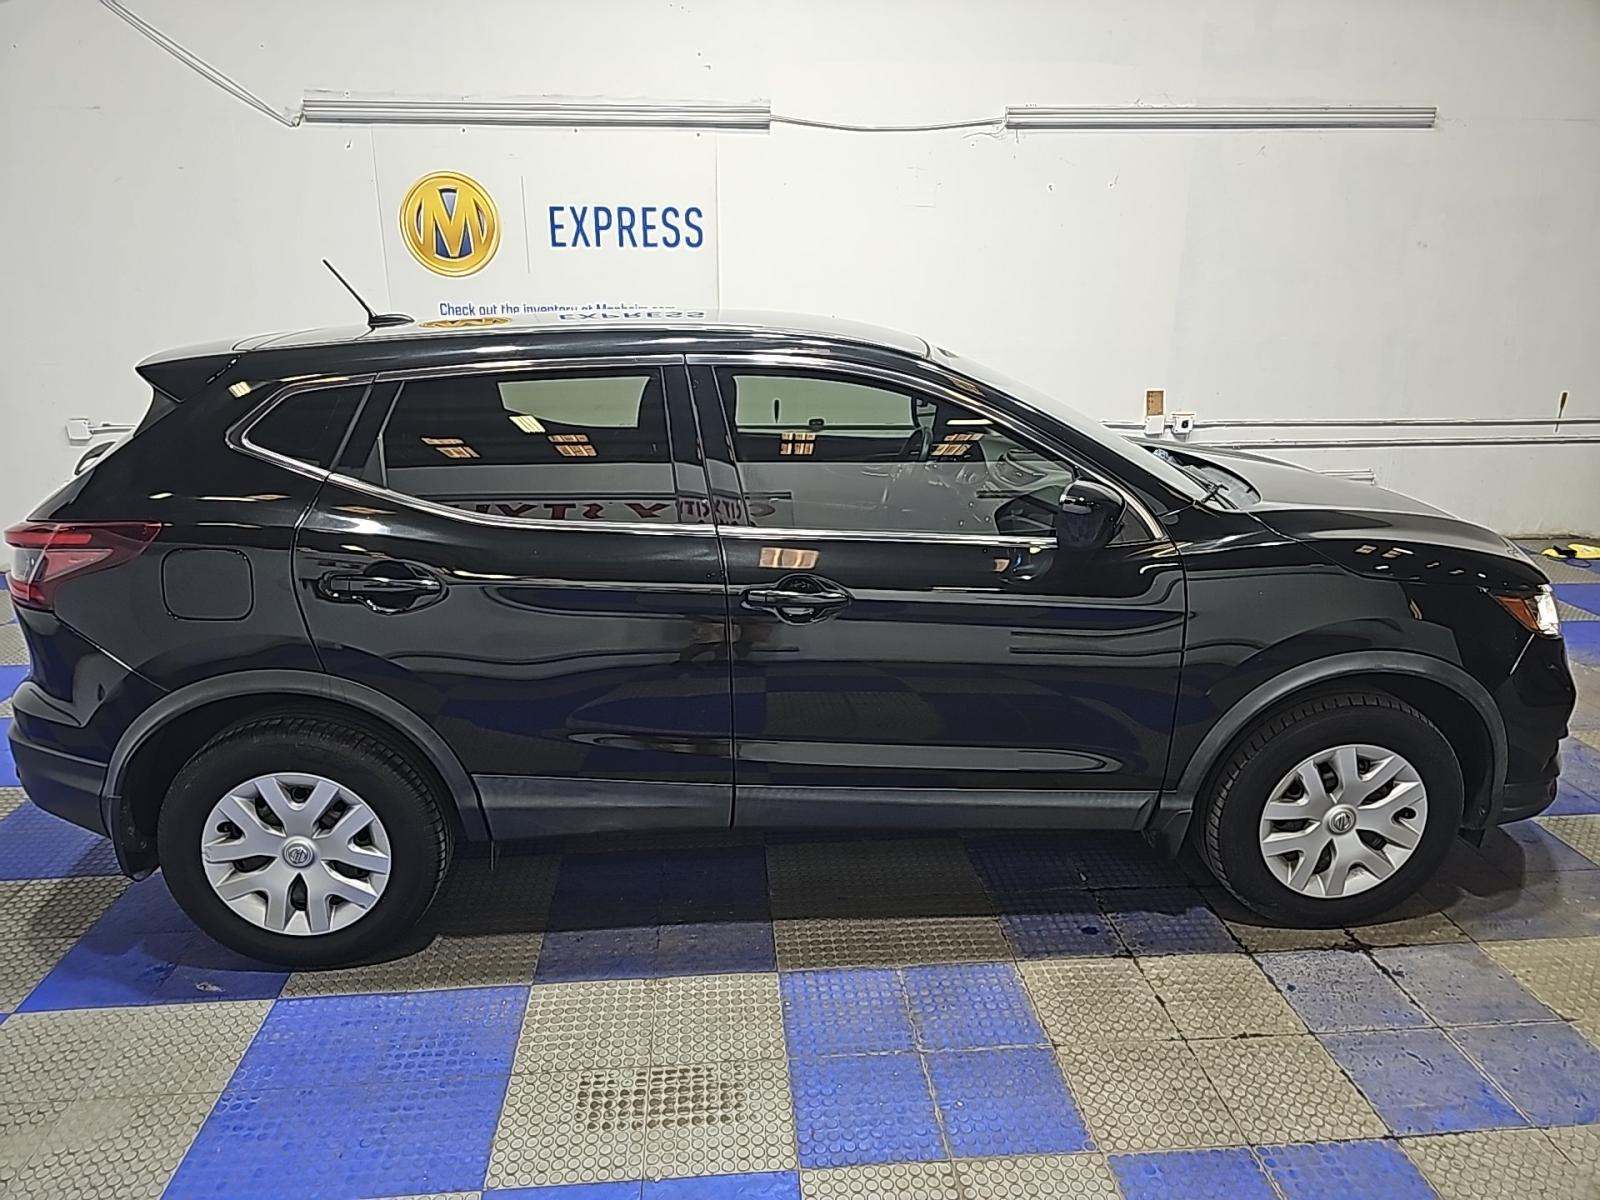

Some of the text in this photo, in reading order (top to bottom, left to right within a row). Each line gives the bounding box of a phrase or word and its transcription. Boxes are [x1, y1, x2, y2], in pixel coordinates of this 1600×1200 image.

[549, 206, 703, 249] EXPRESS
[439, 303, 476, 316] Check
[479, 304, 498, 316] out
[523, 304, 578, 313] invent
